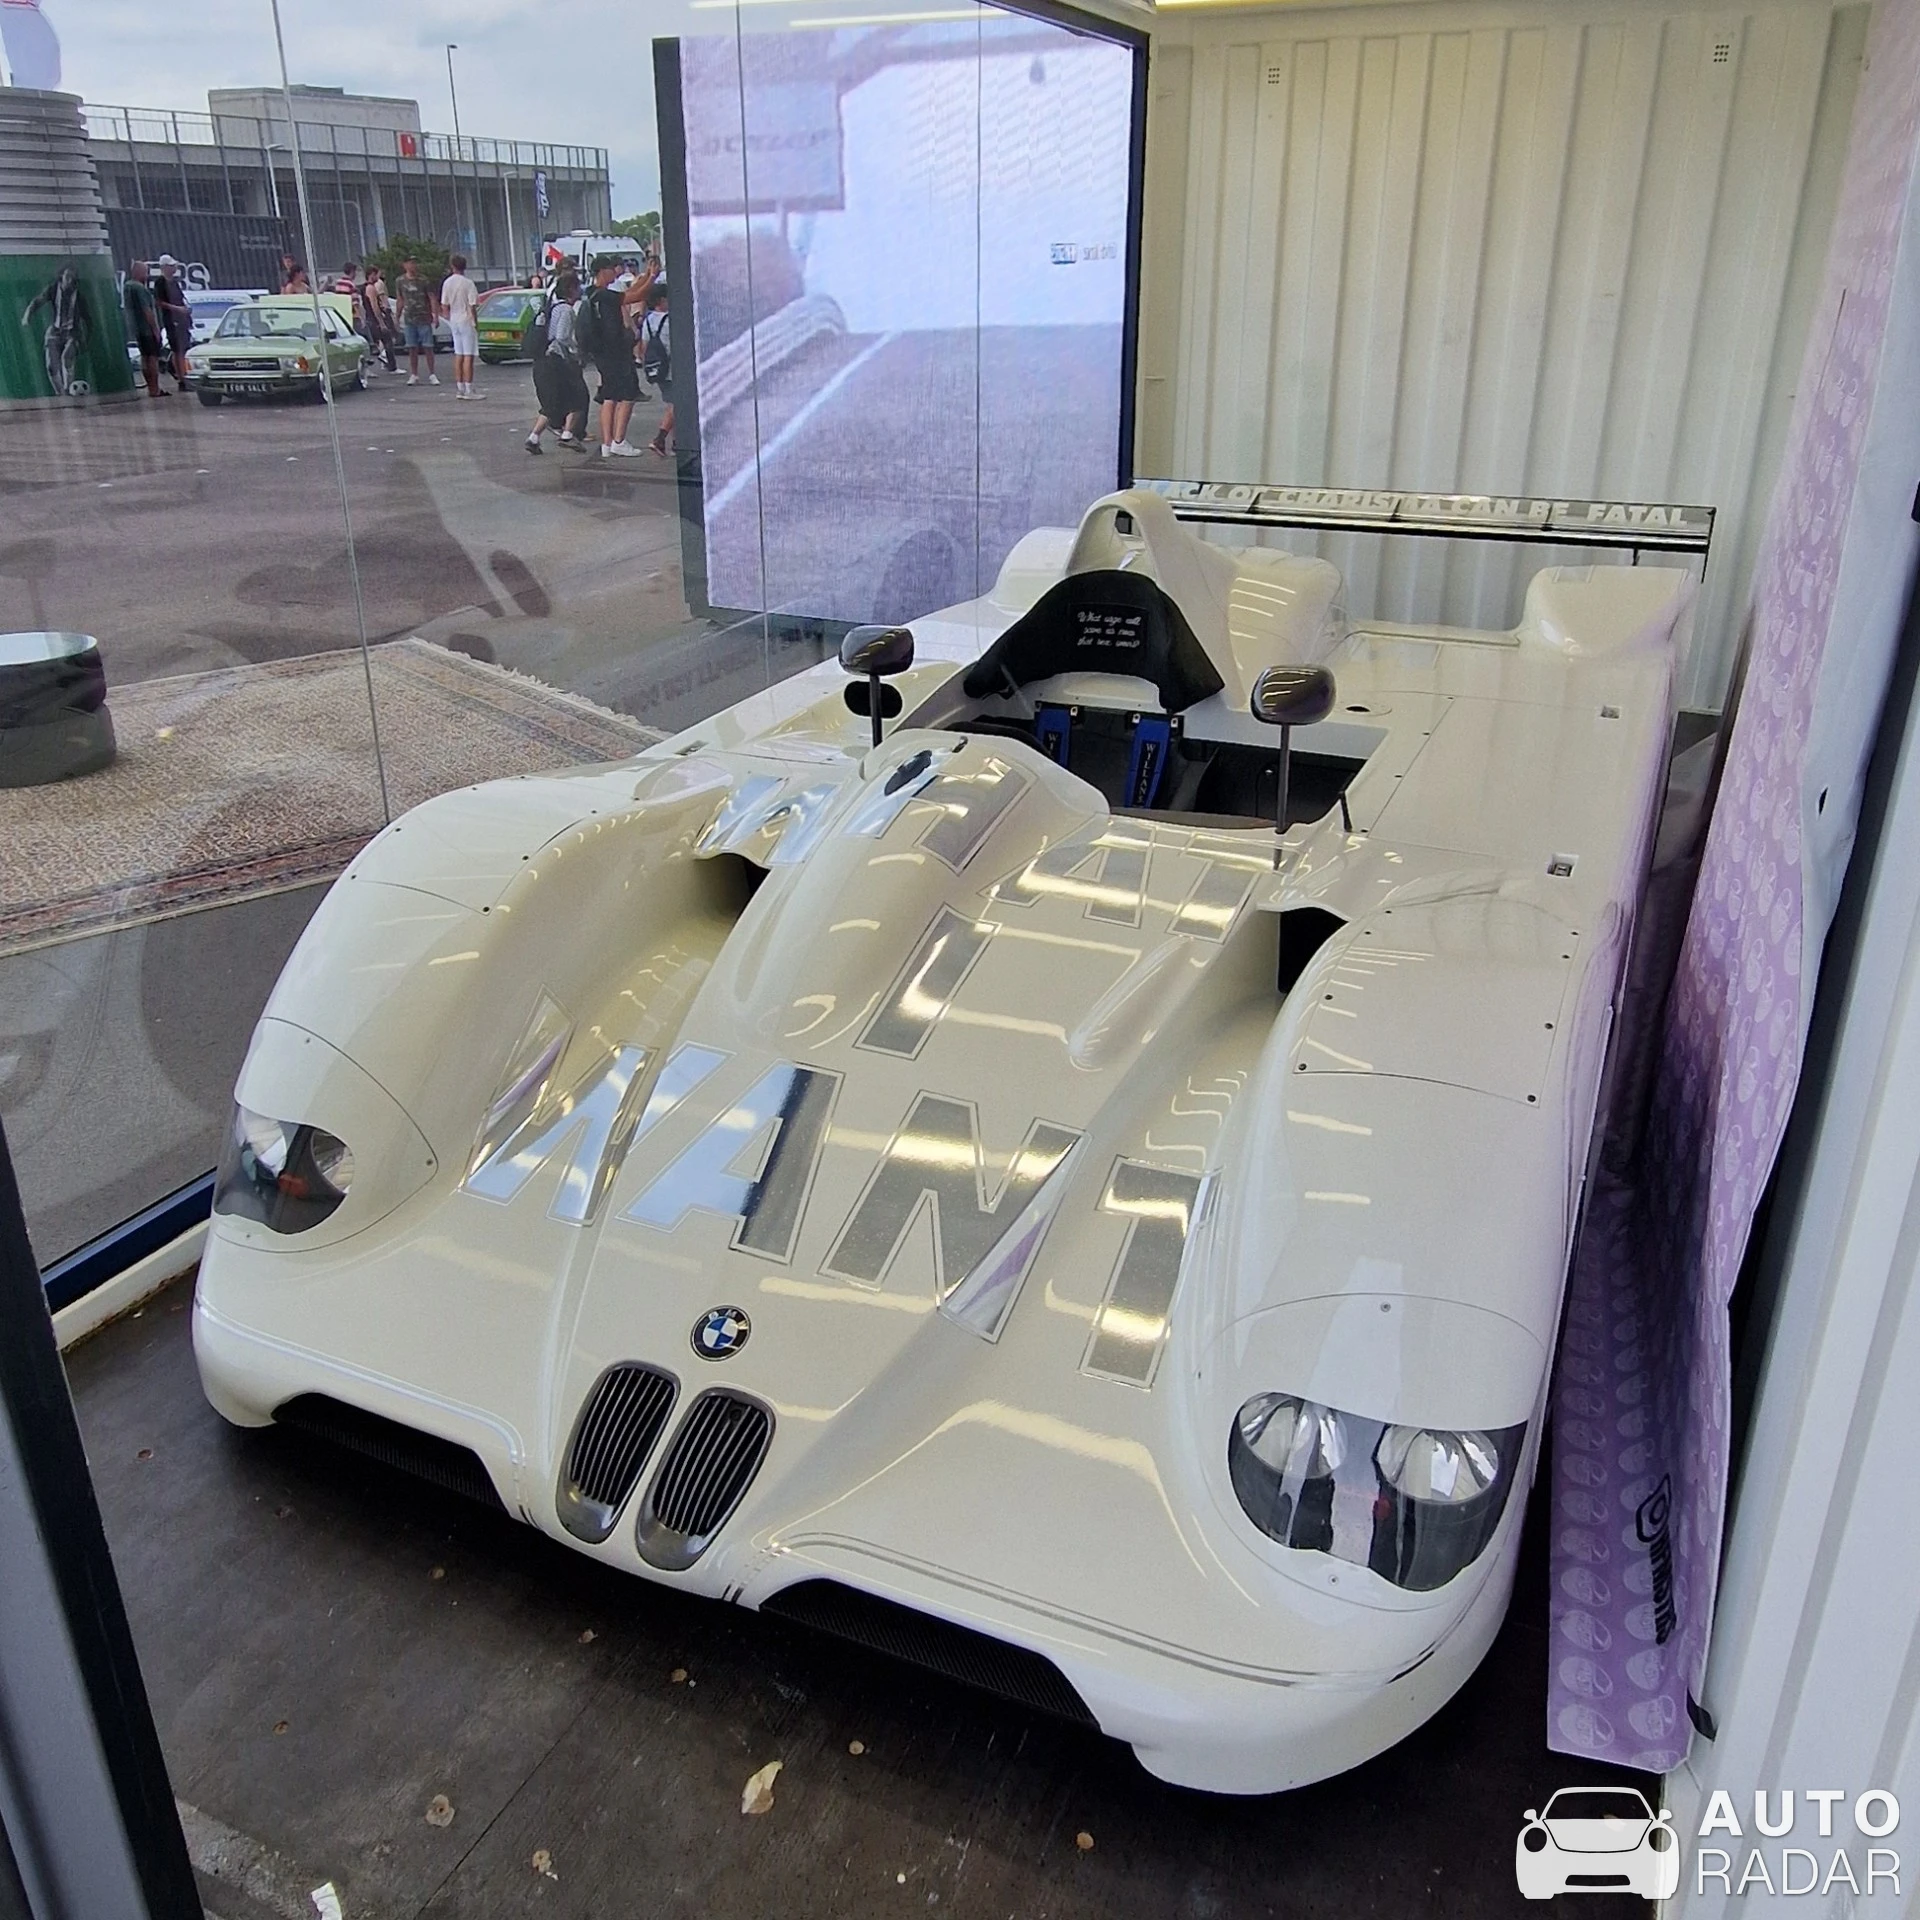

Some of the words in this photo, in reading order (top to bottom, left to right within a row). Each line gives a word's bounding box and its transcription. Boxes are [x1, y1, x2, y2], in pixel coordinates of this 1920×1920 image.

[229, 383, 245, 392] FOR
[247, 384, 267, 393] SALE
[1450, 496, 1521, 517] CAN
[1528, 501, 1571, 520] BE
[1587, 503, 1688, 526] FATAL
[1137, 742, 1157, 805] WILLANS
[854, 902, 1003, 1061] I
[459, 983, 1226, 1393] WANT
